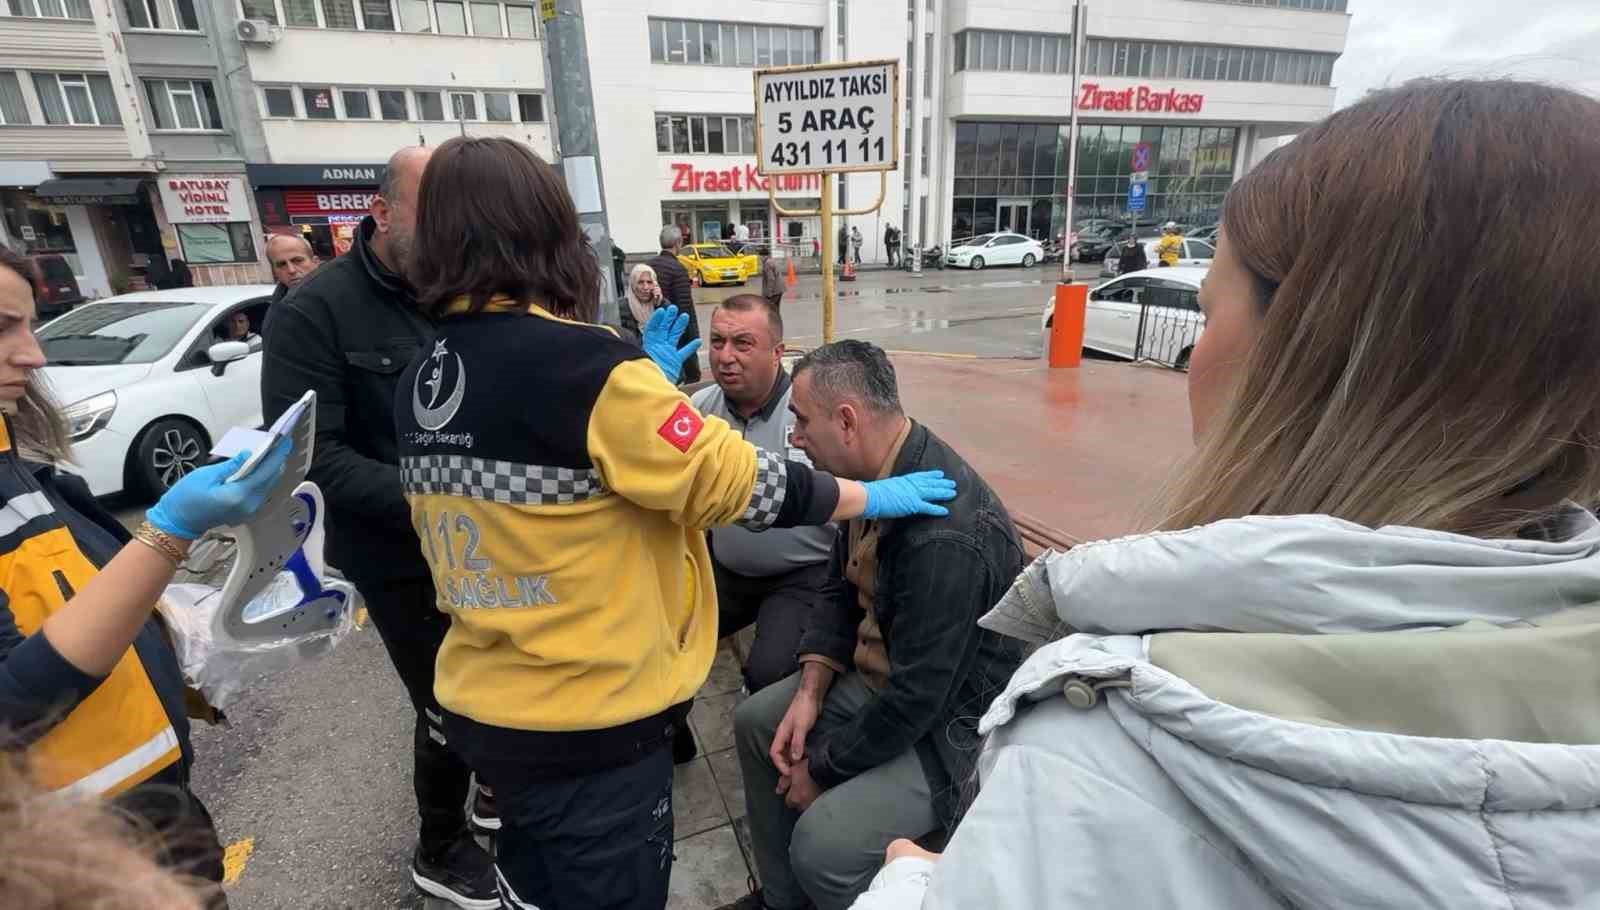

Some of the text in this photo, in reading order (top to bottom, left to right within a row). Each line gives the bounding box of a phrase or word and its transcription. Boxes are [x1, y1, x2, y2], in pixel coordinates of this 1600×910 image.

[764, 68, 888, 103] AYYILDIZ TAKSİ
[1078, 84, 1204, 113] Ziraat Bankası
[778, 106, 875, 134] 5 ARAÇ
[771, 136, 885, 166] 431 11 11
[169, 180, 229, 190] BATUSAY
[322, 168, 376, 179] ADNAN
[671, 163, 742, 192] Ziraat
[184, 205, 230, 216] HOTEL
[422, 511, 491, 570] 112
[447, 574, 557, 608] SAĞLIK
